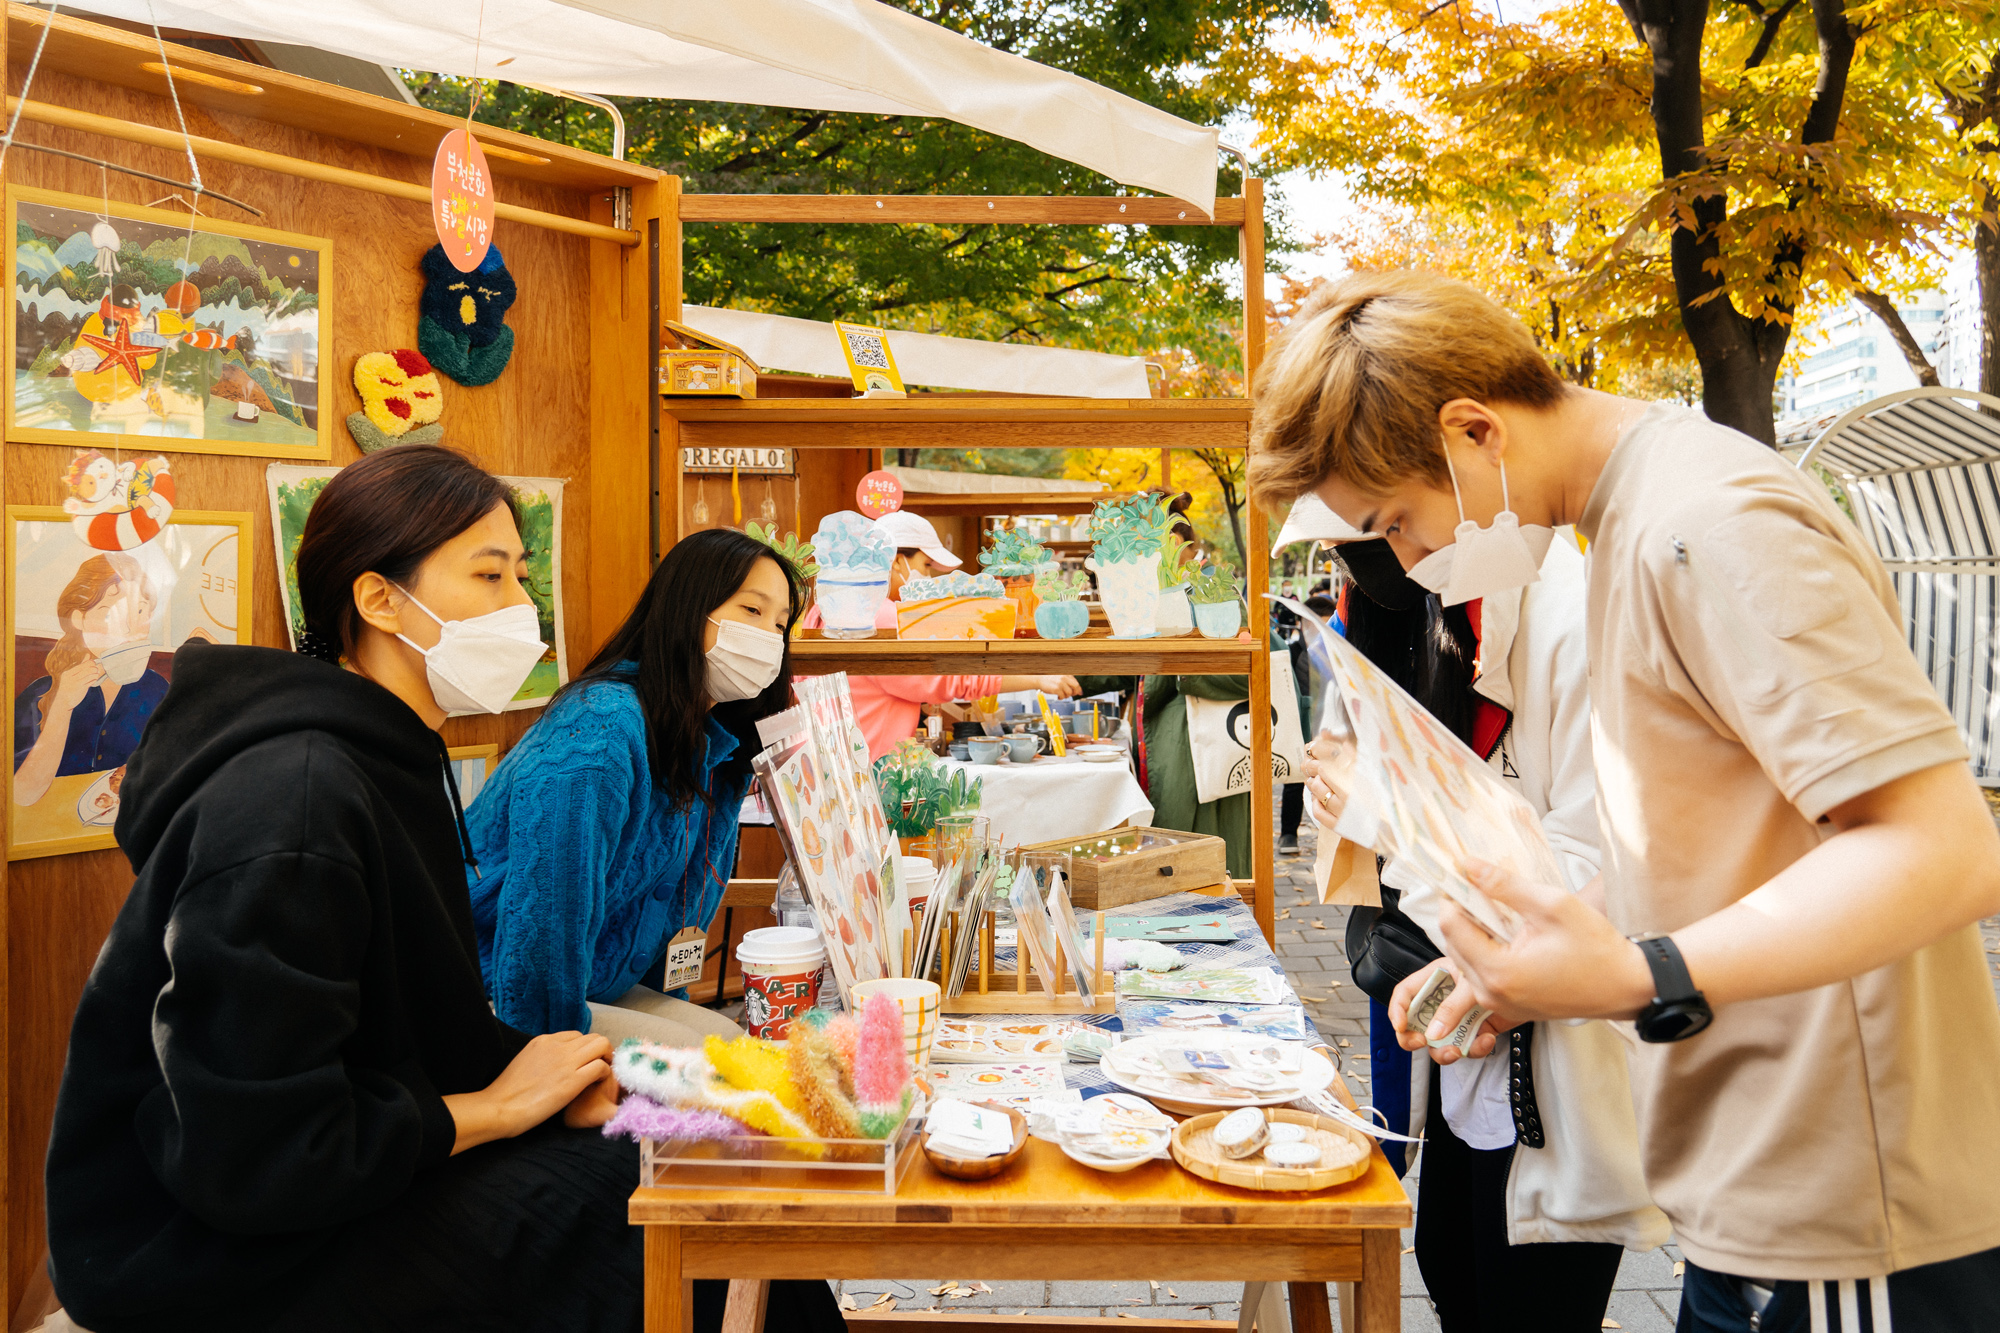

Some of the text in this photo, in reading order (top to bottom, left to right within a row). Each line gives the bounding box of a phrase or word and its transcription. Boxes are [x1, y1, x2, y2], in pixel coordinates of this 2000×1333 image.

[447, 151, 486, 197] 부천문화
[692, 448, 778, 467] REGALO
[867, 478, 897, 493] 부천문화
[670, 944, 703, 964] 아트마켓
[1465, 1010, 1480, 1026] won
